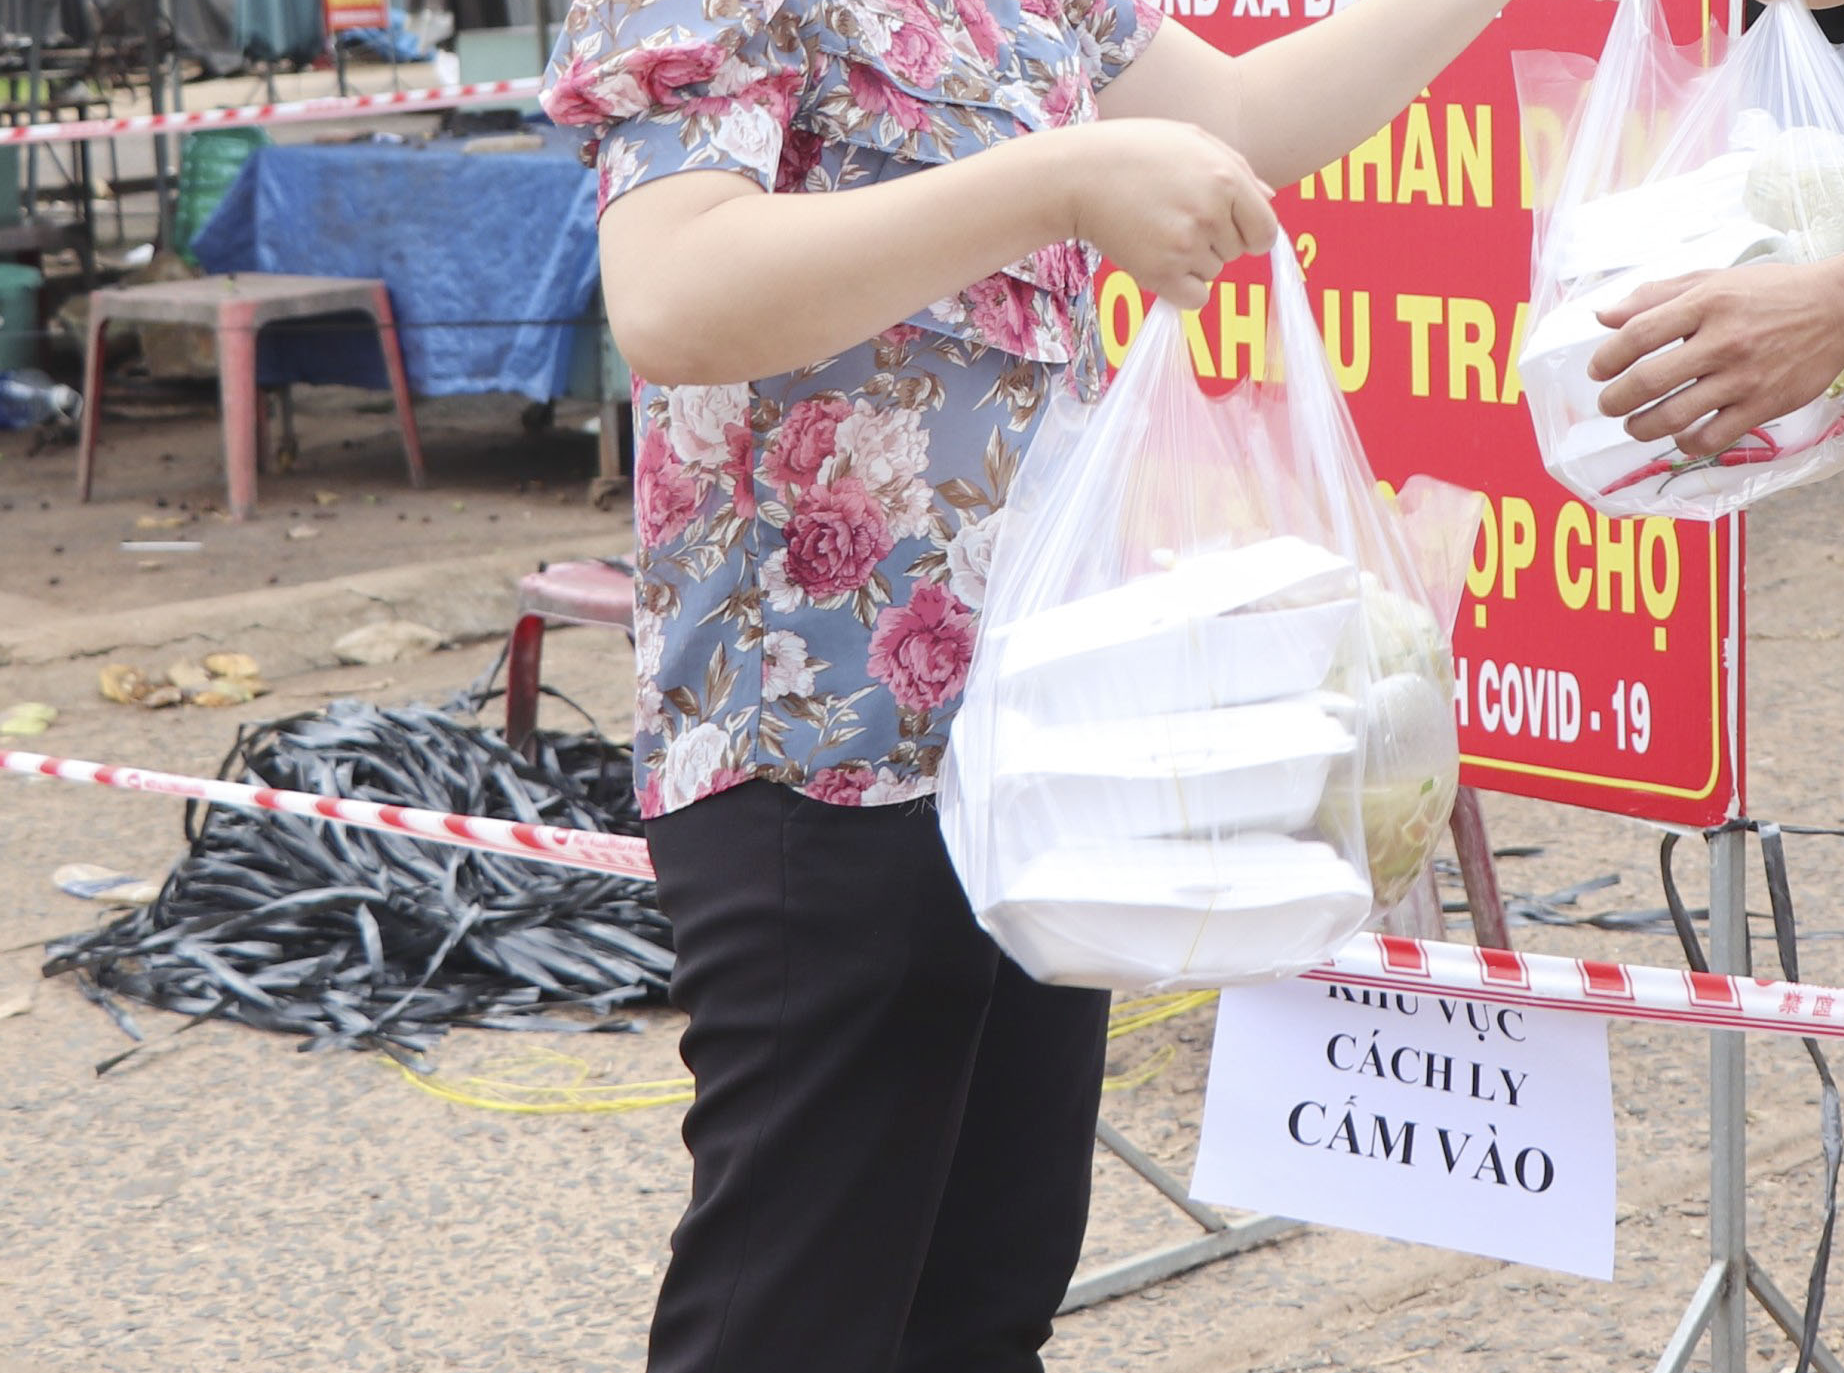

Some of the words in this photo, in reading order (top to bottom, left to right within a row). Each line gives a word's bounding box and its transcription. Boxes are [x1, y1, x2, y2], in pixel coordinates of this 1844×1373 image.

[1180, 232, 1371, 393] KHU
[1396, 293, 1530, 405] TRA
[1465, 490, 1537, 628] ỌP
[1478, 658, 1582, 744] COVID
[1612, 679, 1651, 754] 19
[1326, 1029, 1454, 1092] CÁCH
[1469, 1062, 1529, 1107] LY
[1287, 1095, 1418, 1167] CẤM
[1436, 1123, 1556, 1194] VÀO
